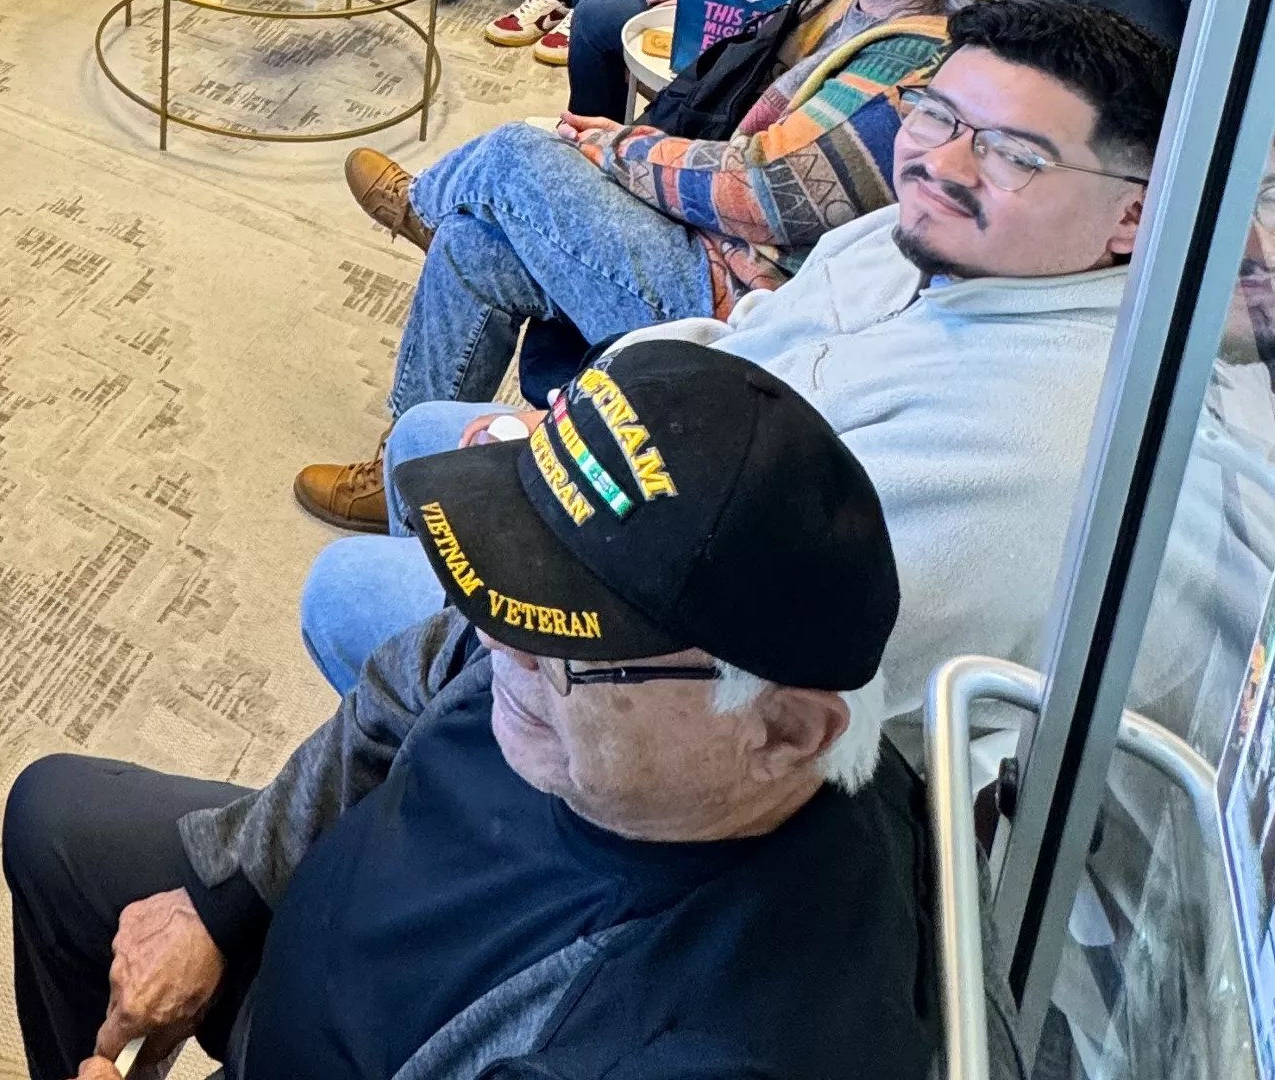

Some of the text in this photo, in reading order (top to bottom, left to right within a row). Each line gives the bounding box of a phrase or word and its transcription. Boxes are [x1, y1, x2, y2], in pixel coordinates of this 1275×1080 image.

[704, 1, 745, 26] THIS
[420, 501, 602, 638] VIETNAM VETERAN
